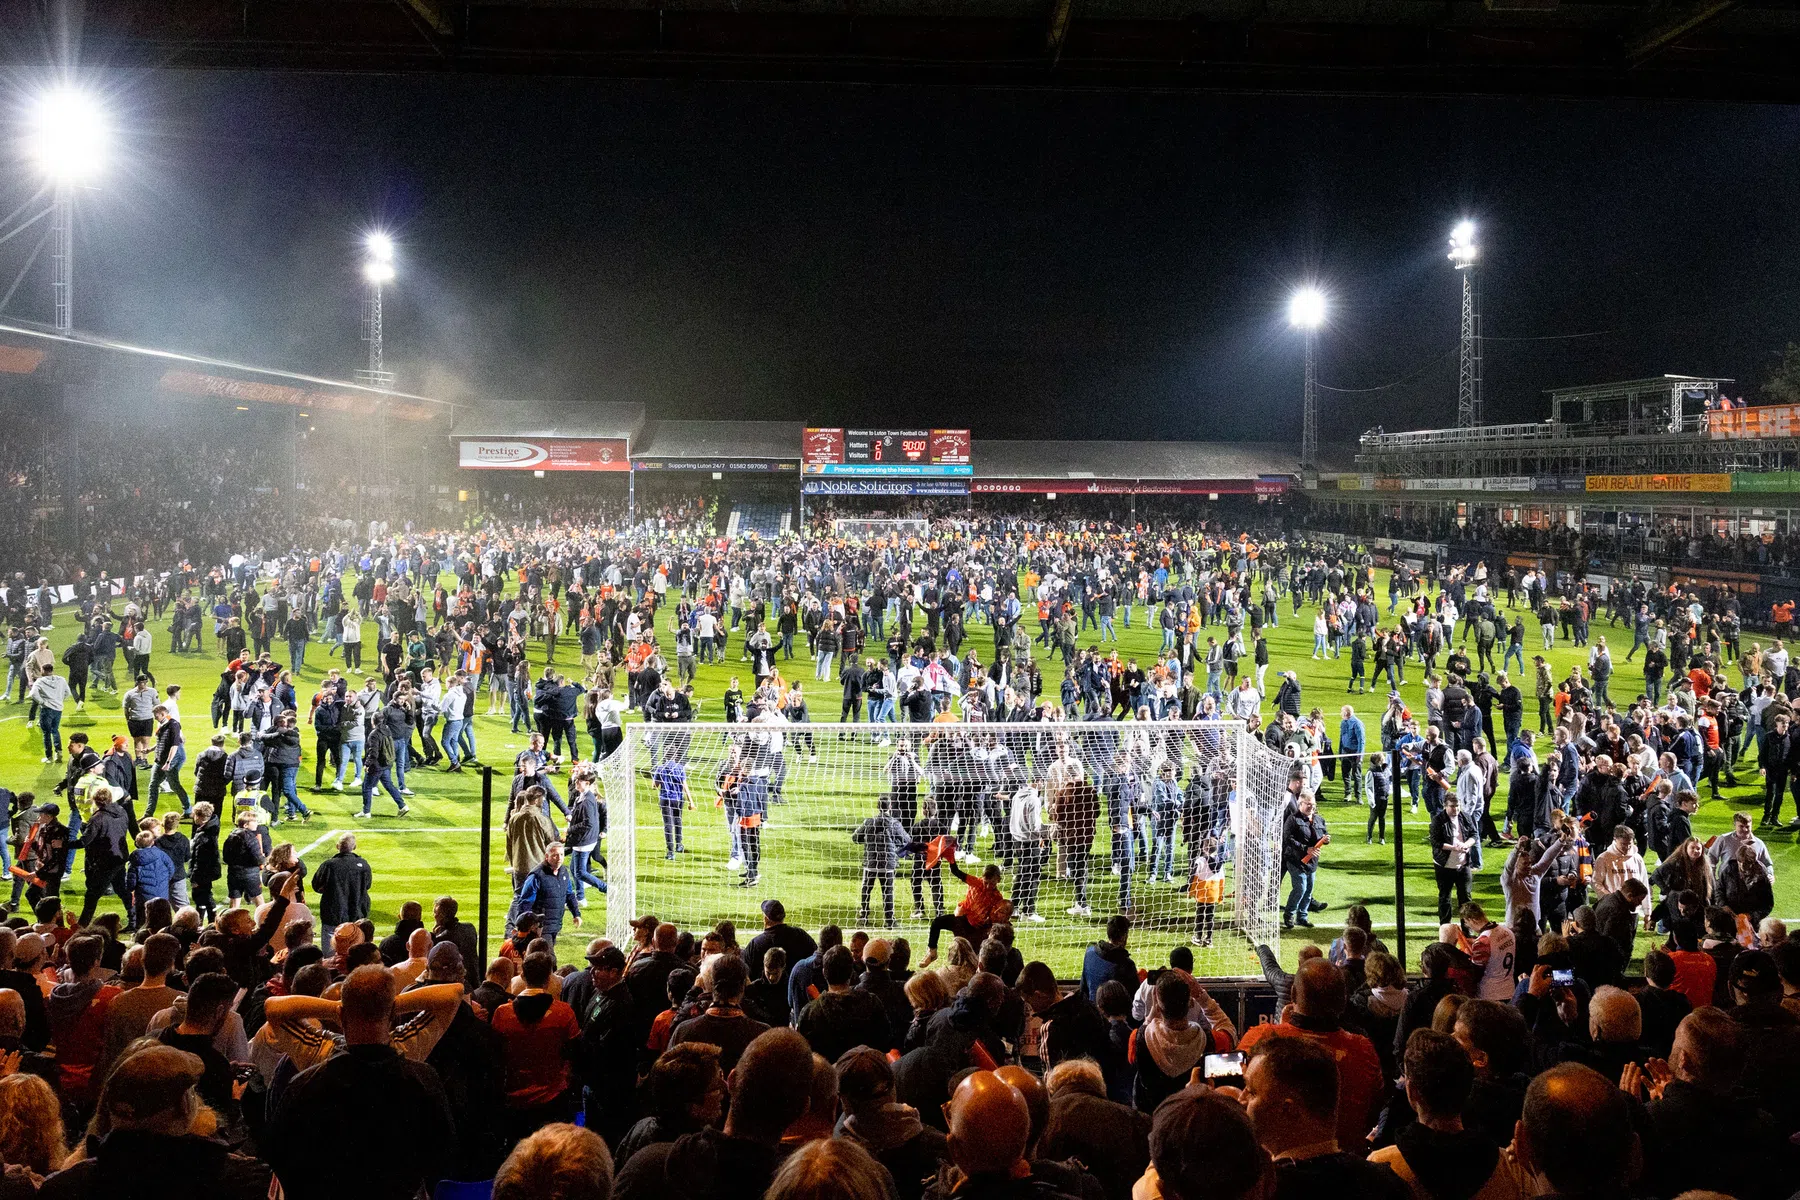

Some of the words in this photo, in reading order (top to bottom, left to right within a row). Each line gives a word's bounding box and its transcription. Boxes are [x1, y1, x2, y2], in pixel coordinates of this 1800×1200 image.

[875, 440, 882, 450] 2
[902, 440, 926, 451] 90:00
[933, 435, 953, 446] Master
[478, 446, 520, 456] Prestige
[875, 451, 882, 460] 0
[820, 481, 857, 491] Noble
[859, 480, 913, 491] Solicitors
[1588, 477, 1608, 490] SUN
[1611, 477, 1643, 490] REALM
[1646, 476, 1691, 490] HEATING
[1101, 485, 1132, 493] University
[1502, 952, 1513, 979] 9
